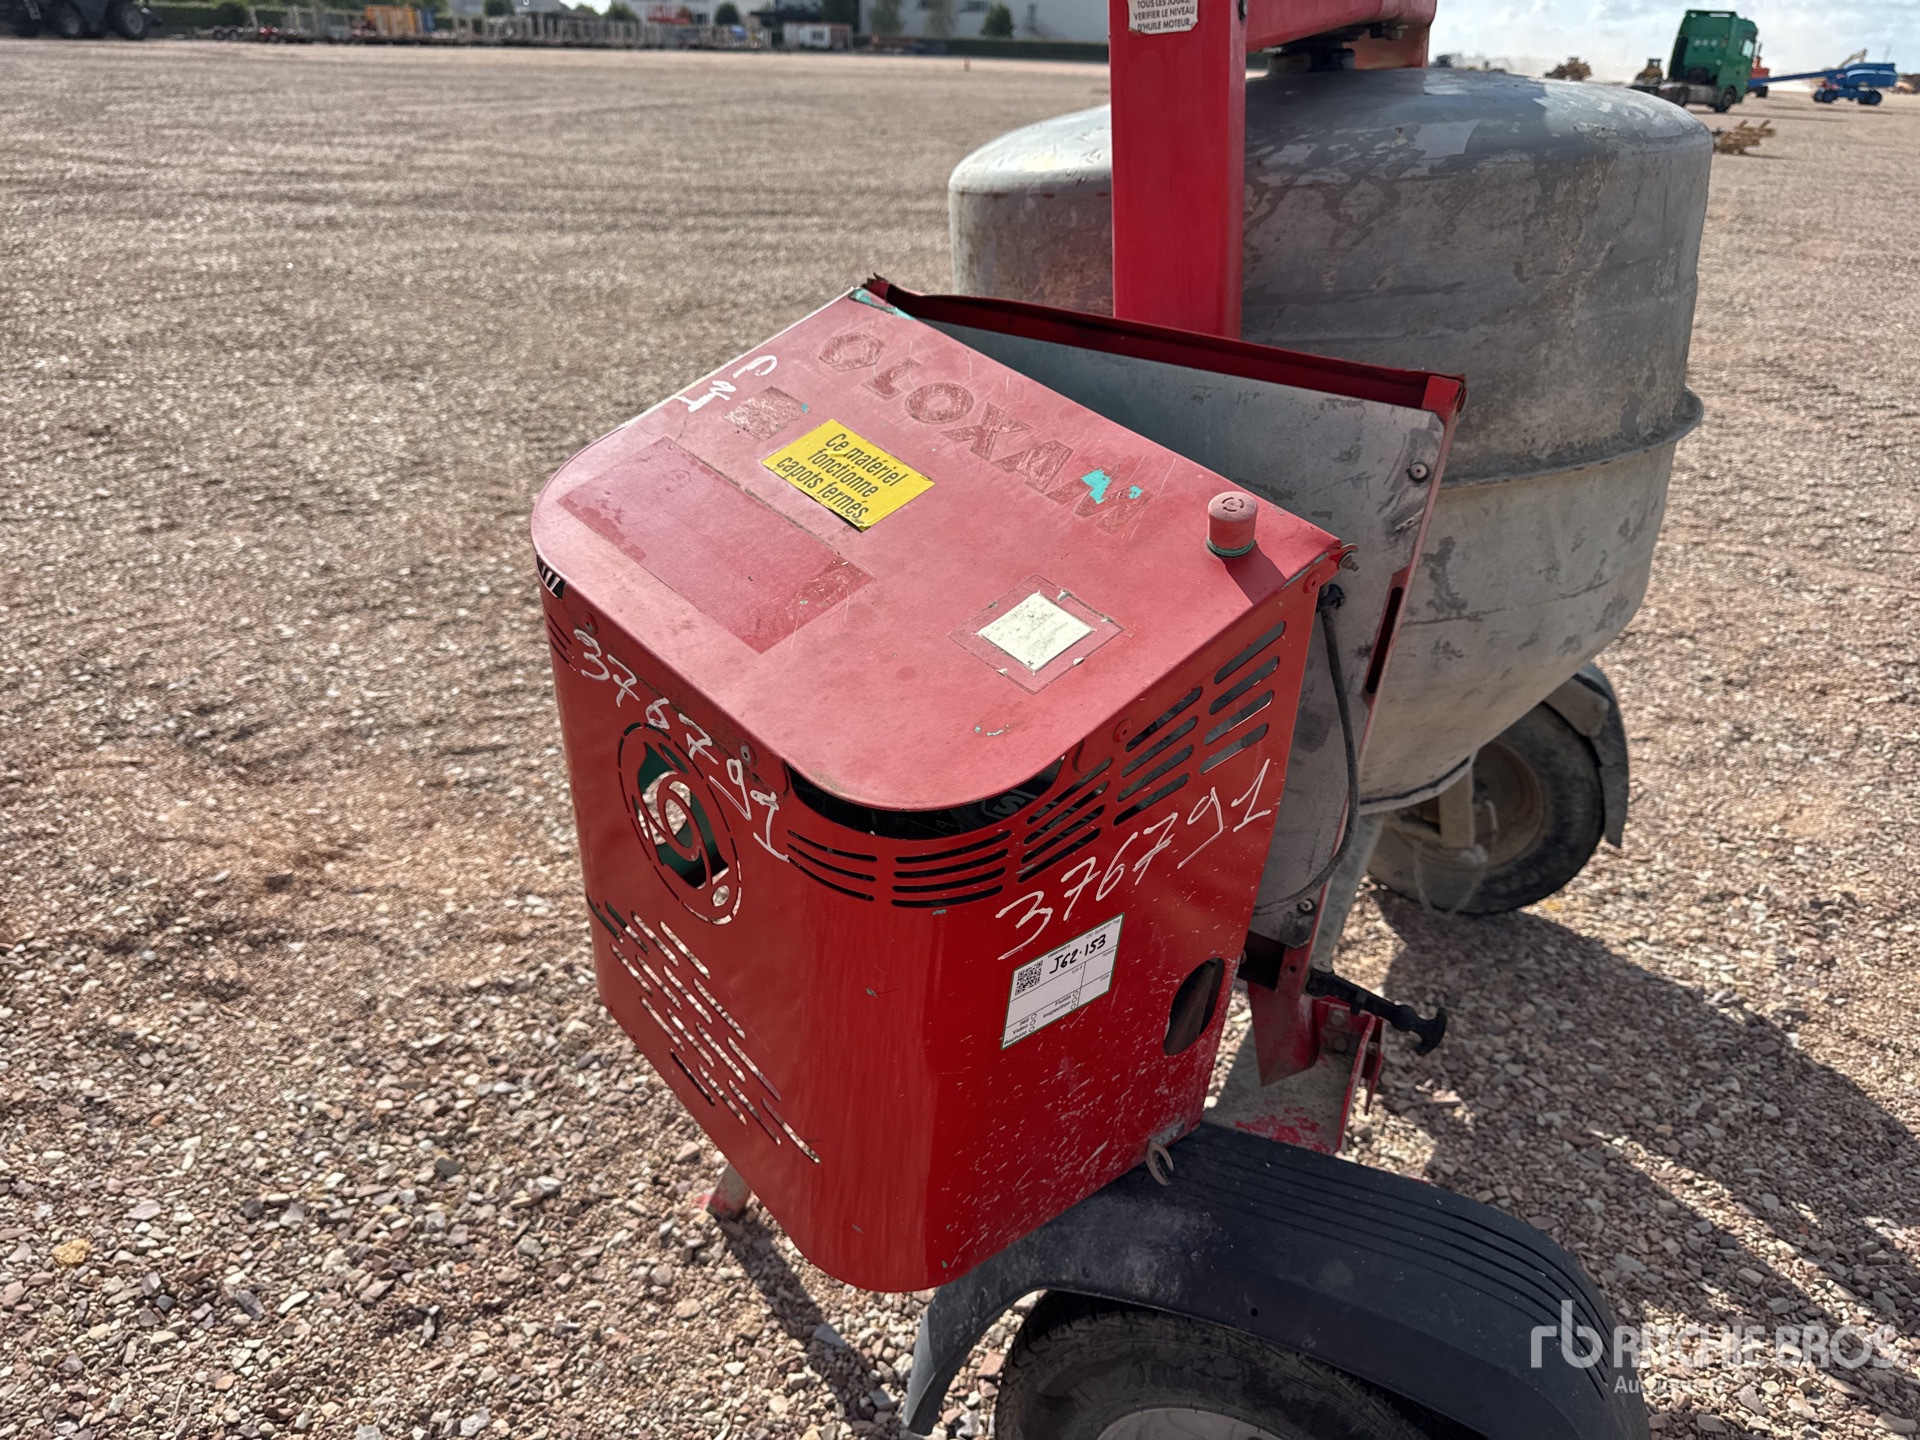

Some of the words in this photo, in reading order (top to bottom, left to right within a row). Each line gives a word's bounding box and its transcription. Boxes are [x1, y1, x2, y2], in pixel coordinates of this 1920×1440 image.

[1134, 11, 1160, 20] VERIFIER
[1161, 9, 1169, 18] LE
[1170, 6, 1194, 16] NIVEAU
[1137, 0, 1154, 9] TOUS
[808, 449, 879, 498] fonctionne
[825, 433, 849, 454] Ce
[844, 446, 908, 487] matériel
[777, 456, 825, 490] capots
[817, 481, 870, 519] fermés
[995, 759, 1271, 960] 376791
[1013, 1024, 1028, 1034] Video
